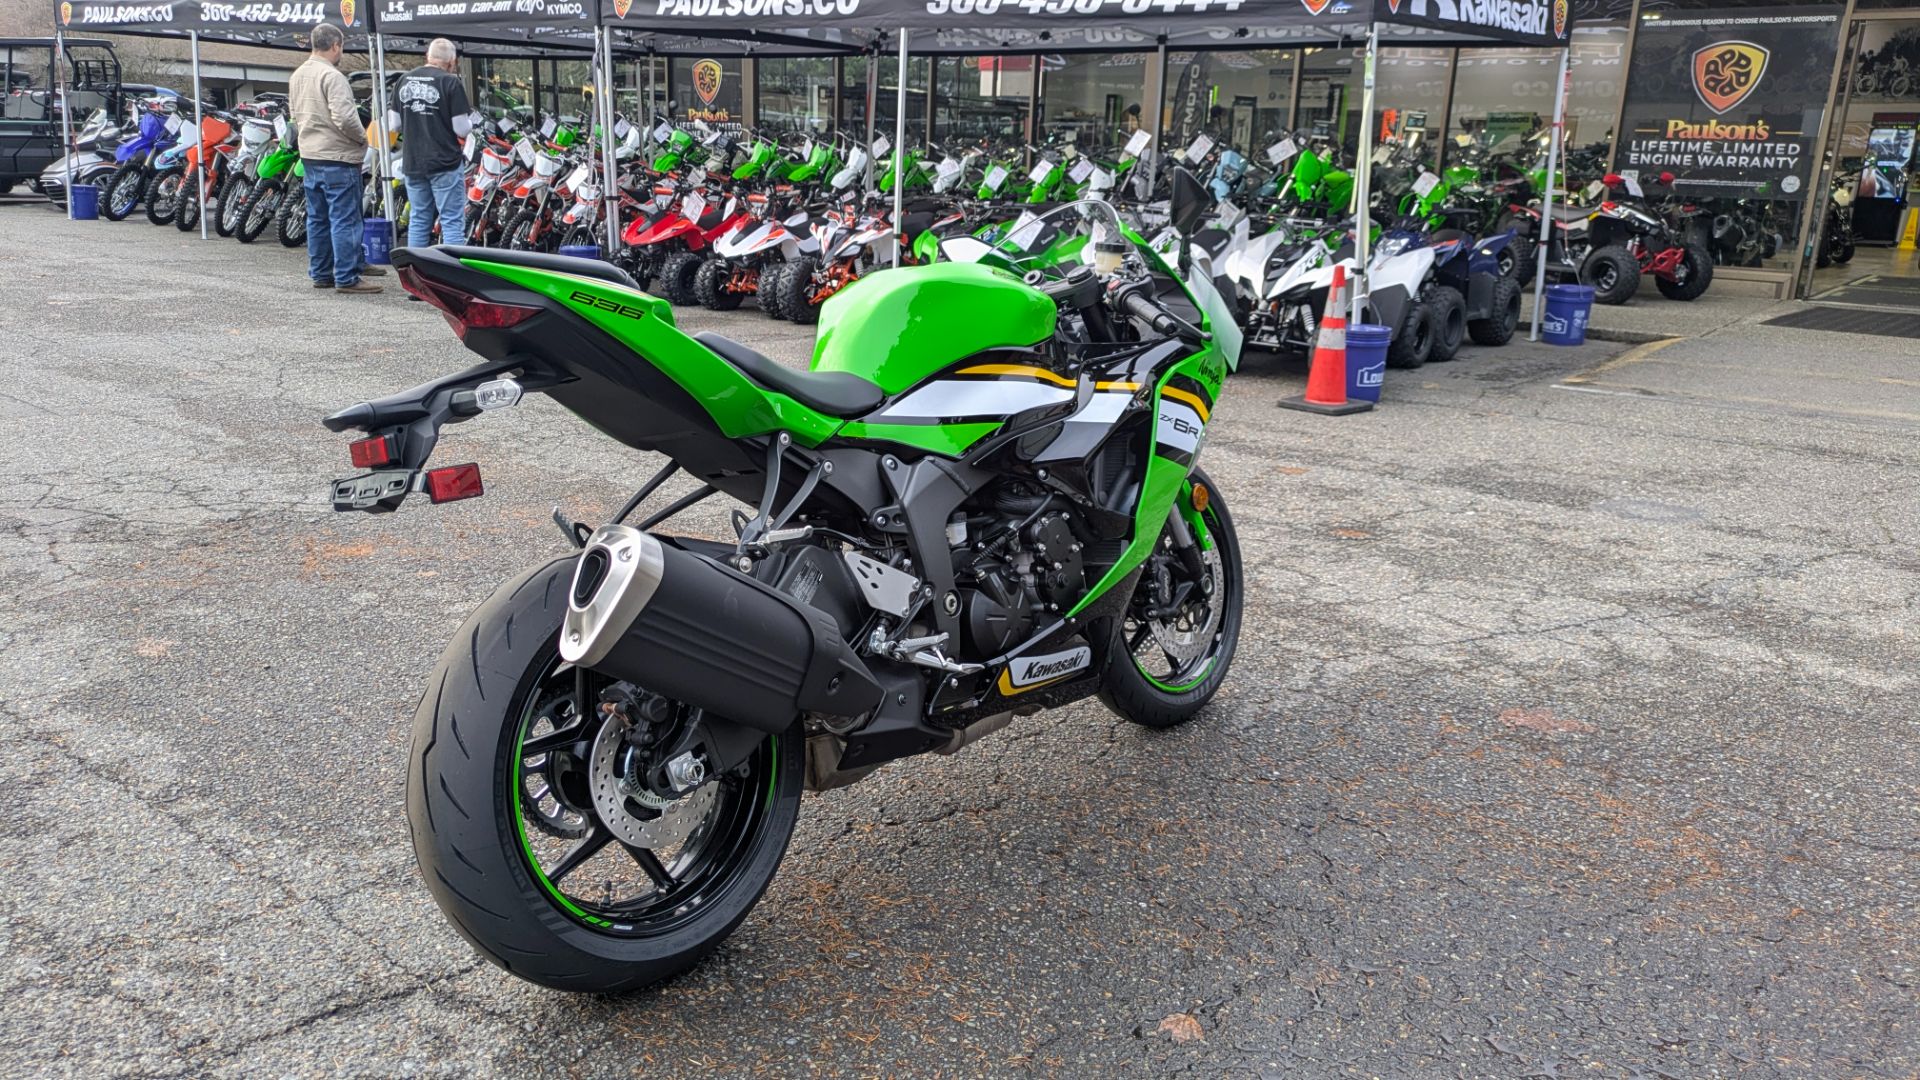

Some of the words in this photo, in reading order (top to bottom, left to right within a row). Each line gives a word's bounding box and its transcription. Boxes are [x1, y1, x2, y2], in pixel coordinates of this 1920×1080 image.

[200, 2, 326, 23] 360-456-8444
[381, 9, 413, 22] Kawasaki
[547, 3, 582, 15] KYMCO
[1759, 16, 1791, 24] PAULSON'S
[1666, 119, 1770, 141] Paulson's
[1631, 140, 1713, 153] LIFETIME
[1722, 142, 1801, 155] LIMITED
[1629, 153, 1693, 166] ENGINE
[1697, 155, 1799, 169] WARRANTY
[569, 290, 645, 320] 636
[1199, 358, 1221, 385] Ninja
[1022, 651, 1086, 681] Kawasaki
